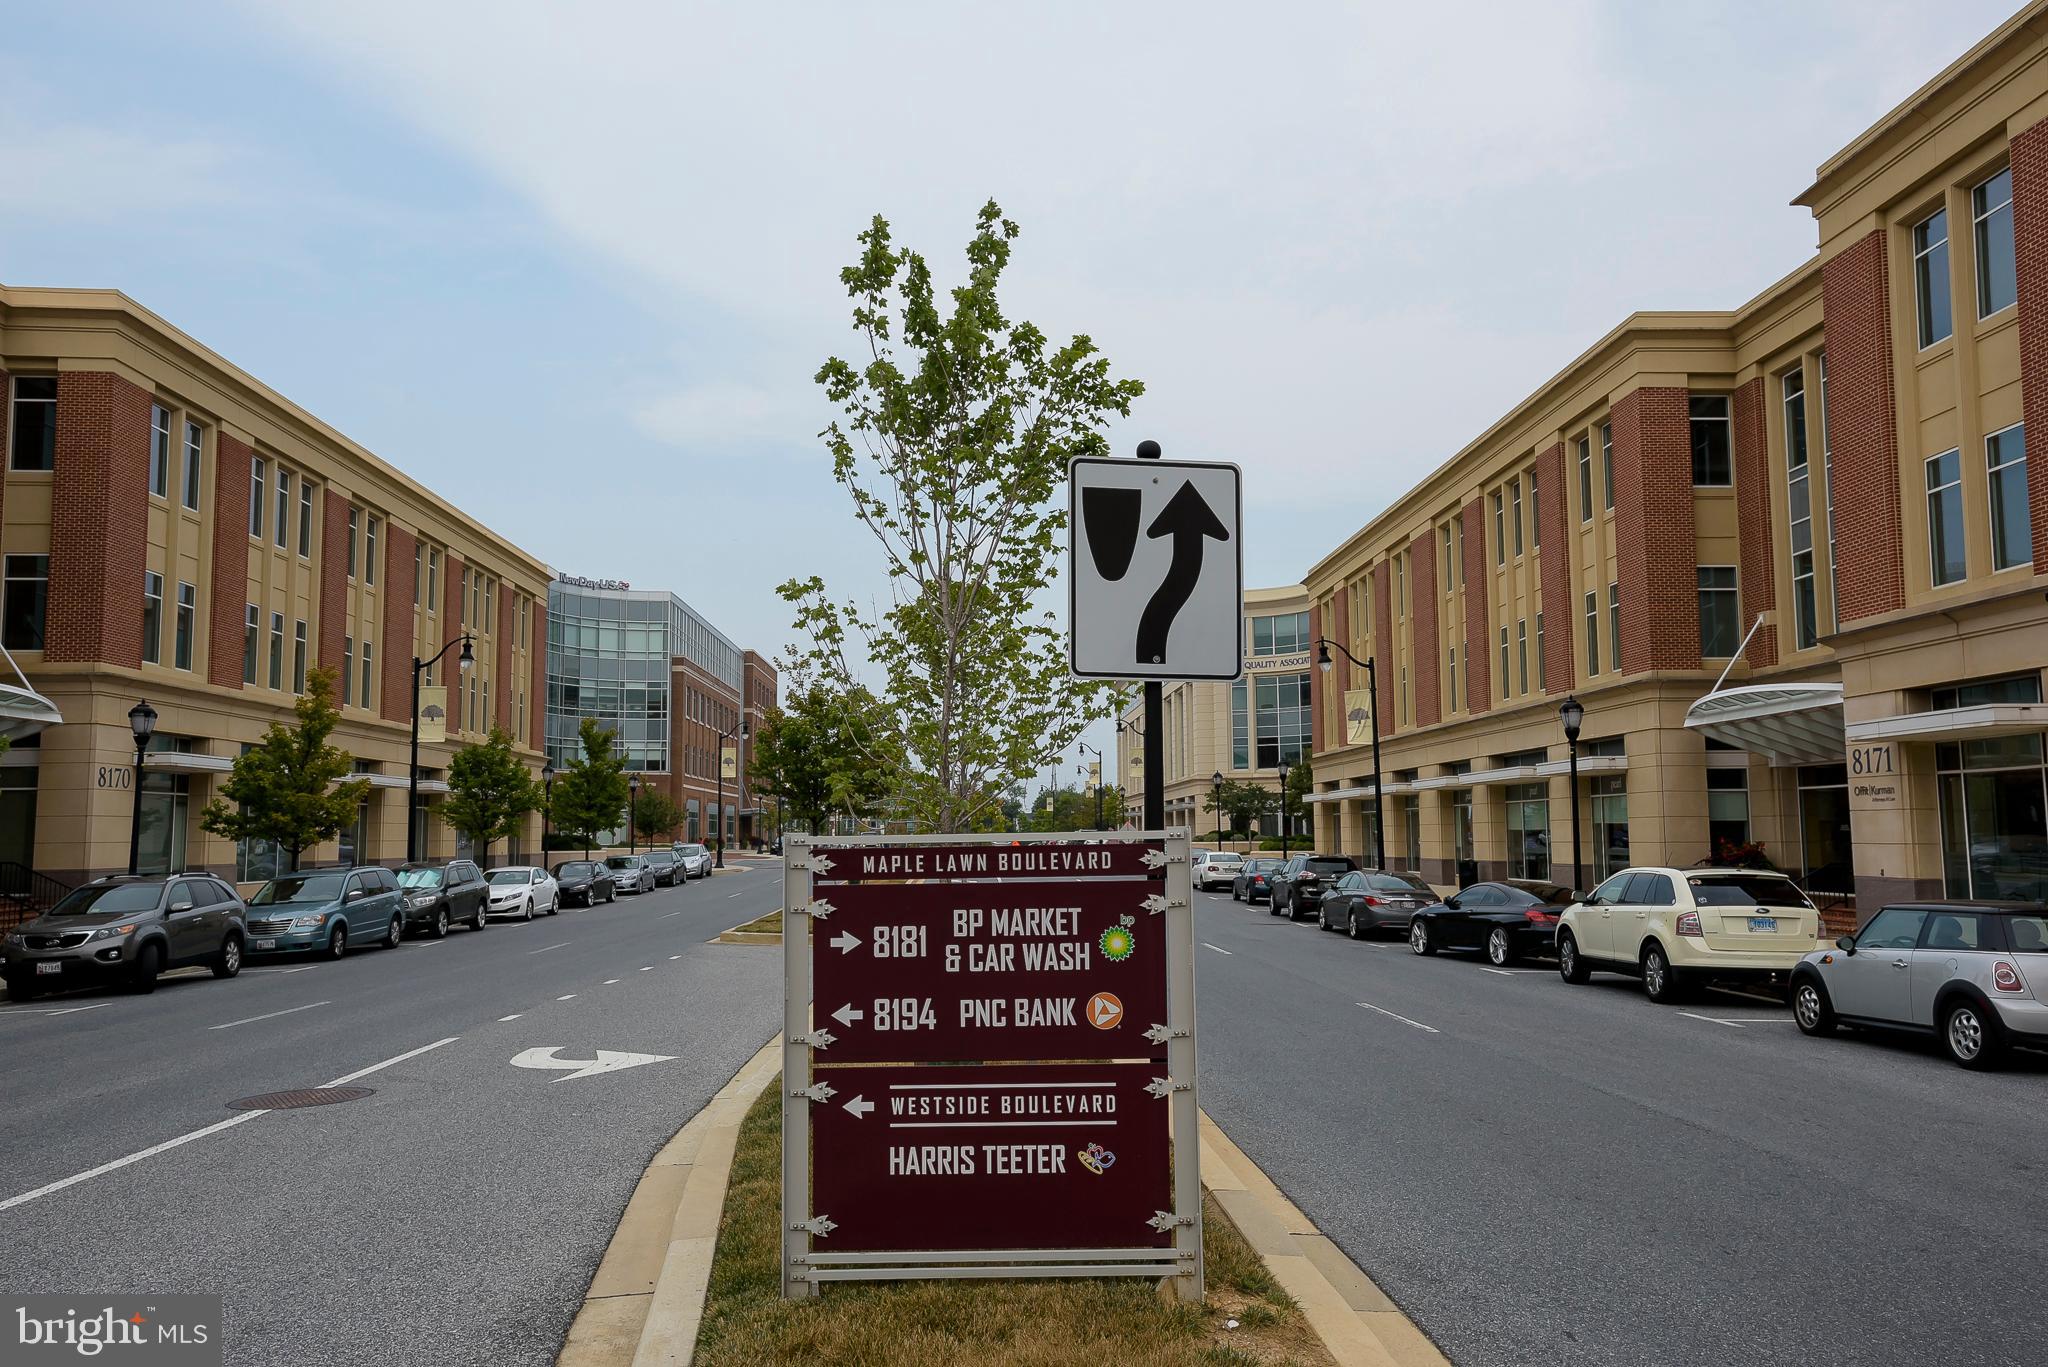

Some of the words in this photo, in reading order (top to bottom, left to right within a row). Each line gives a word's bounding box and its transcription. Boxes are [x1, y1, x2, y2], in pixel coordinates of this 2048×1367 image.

[1244, 660, 1277, 670] QUALITY
[1852, 745, 1894, 775] 8171
[97, 766, 131, 789] 8170
[863, 854, 924, 873] MAPLE
[936, 853, 987, 872] LAWN
[998, 851, 1111, 871] BOULEVARD
[953, 909, 983, 937] BP
[991, 907, 1081, 937] MARKET
[1119, 913, 1136, 928] bp
[873, 925, 927, 958] 8181
[945, 944, 961, 972] &
[969, 943, 1015, 971] CAR
[1023, 942, 1090, 971] WASH
[874, 998, 937, 1031] 8194
[960, 998, 1007, 1028] PNC
[1014, 997, 1077, 1027] BANK
[890, 1096, 990, 1116] WESTSIDE
[1001, 1094, 1116, 1114] BOULEVARD
[889, 1145, 975, 1176] HARRIS
[982, 1144, 1066, 1174] TEETER
